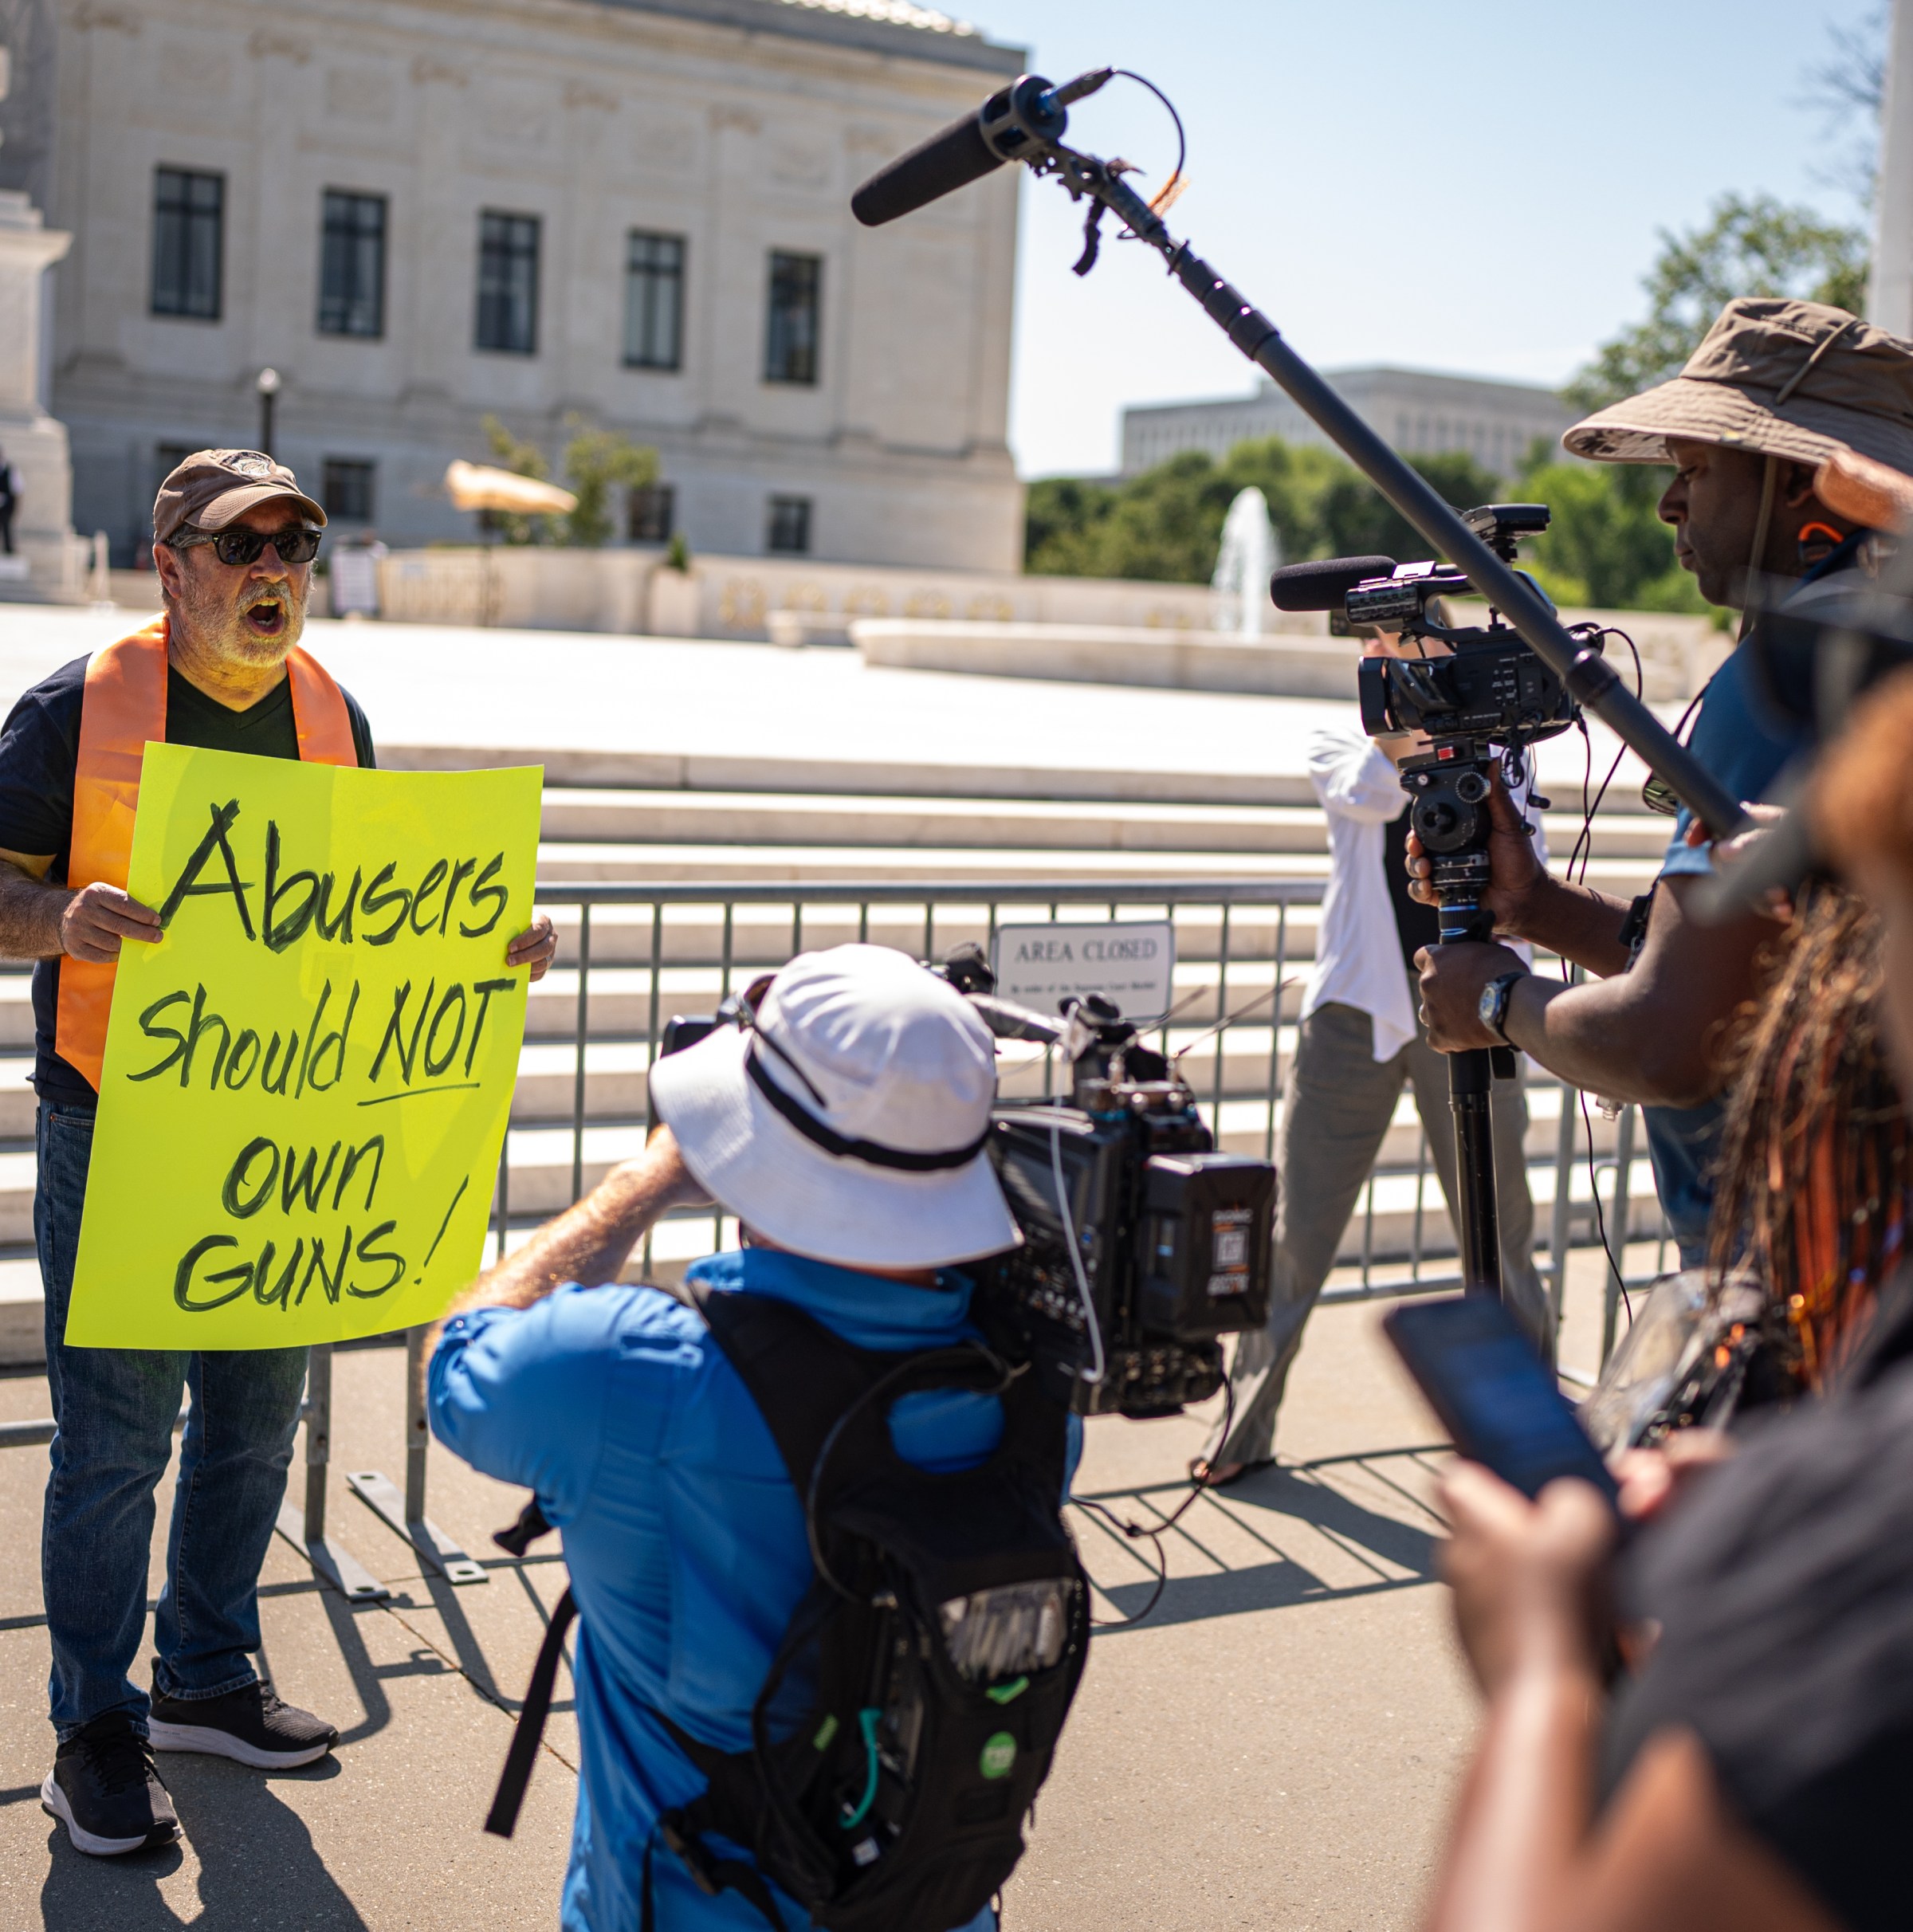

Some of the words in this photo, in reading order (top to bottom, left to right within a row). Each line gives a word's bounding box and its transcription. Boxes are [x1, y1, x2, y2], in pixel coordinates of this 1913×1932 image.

[161, 798, 509, 955] Abusers
[1015, 941, 1074, 963] AREA
[1082, 939, 1157, 962] CLOSED
[368, 977, 517, 1086] NOT
